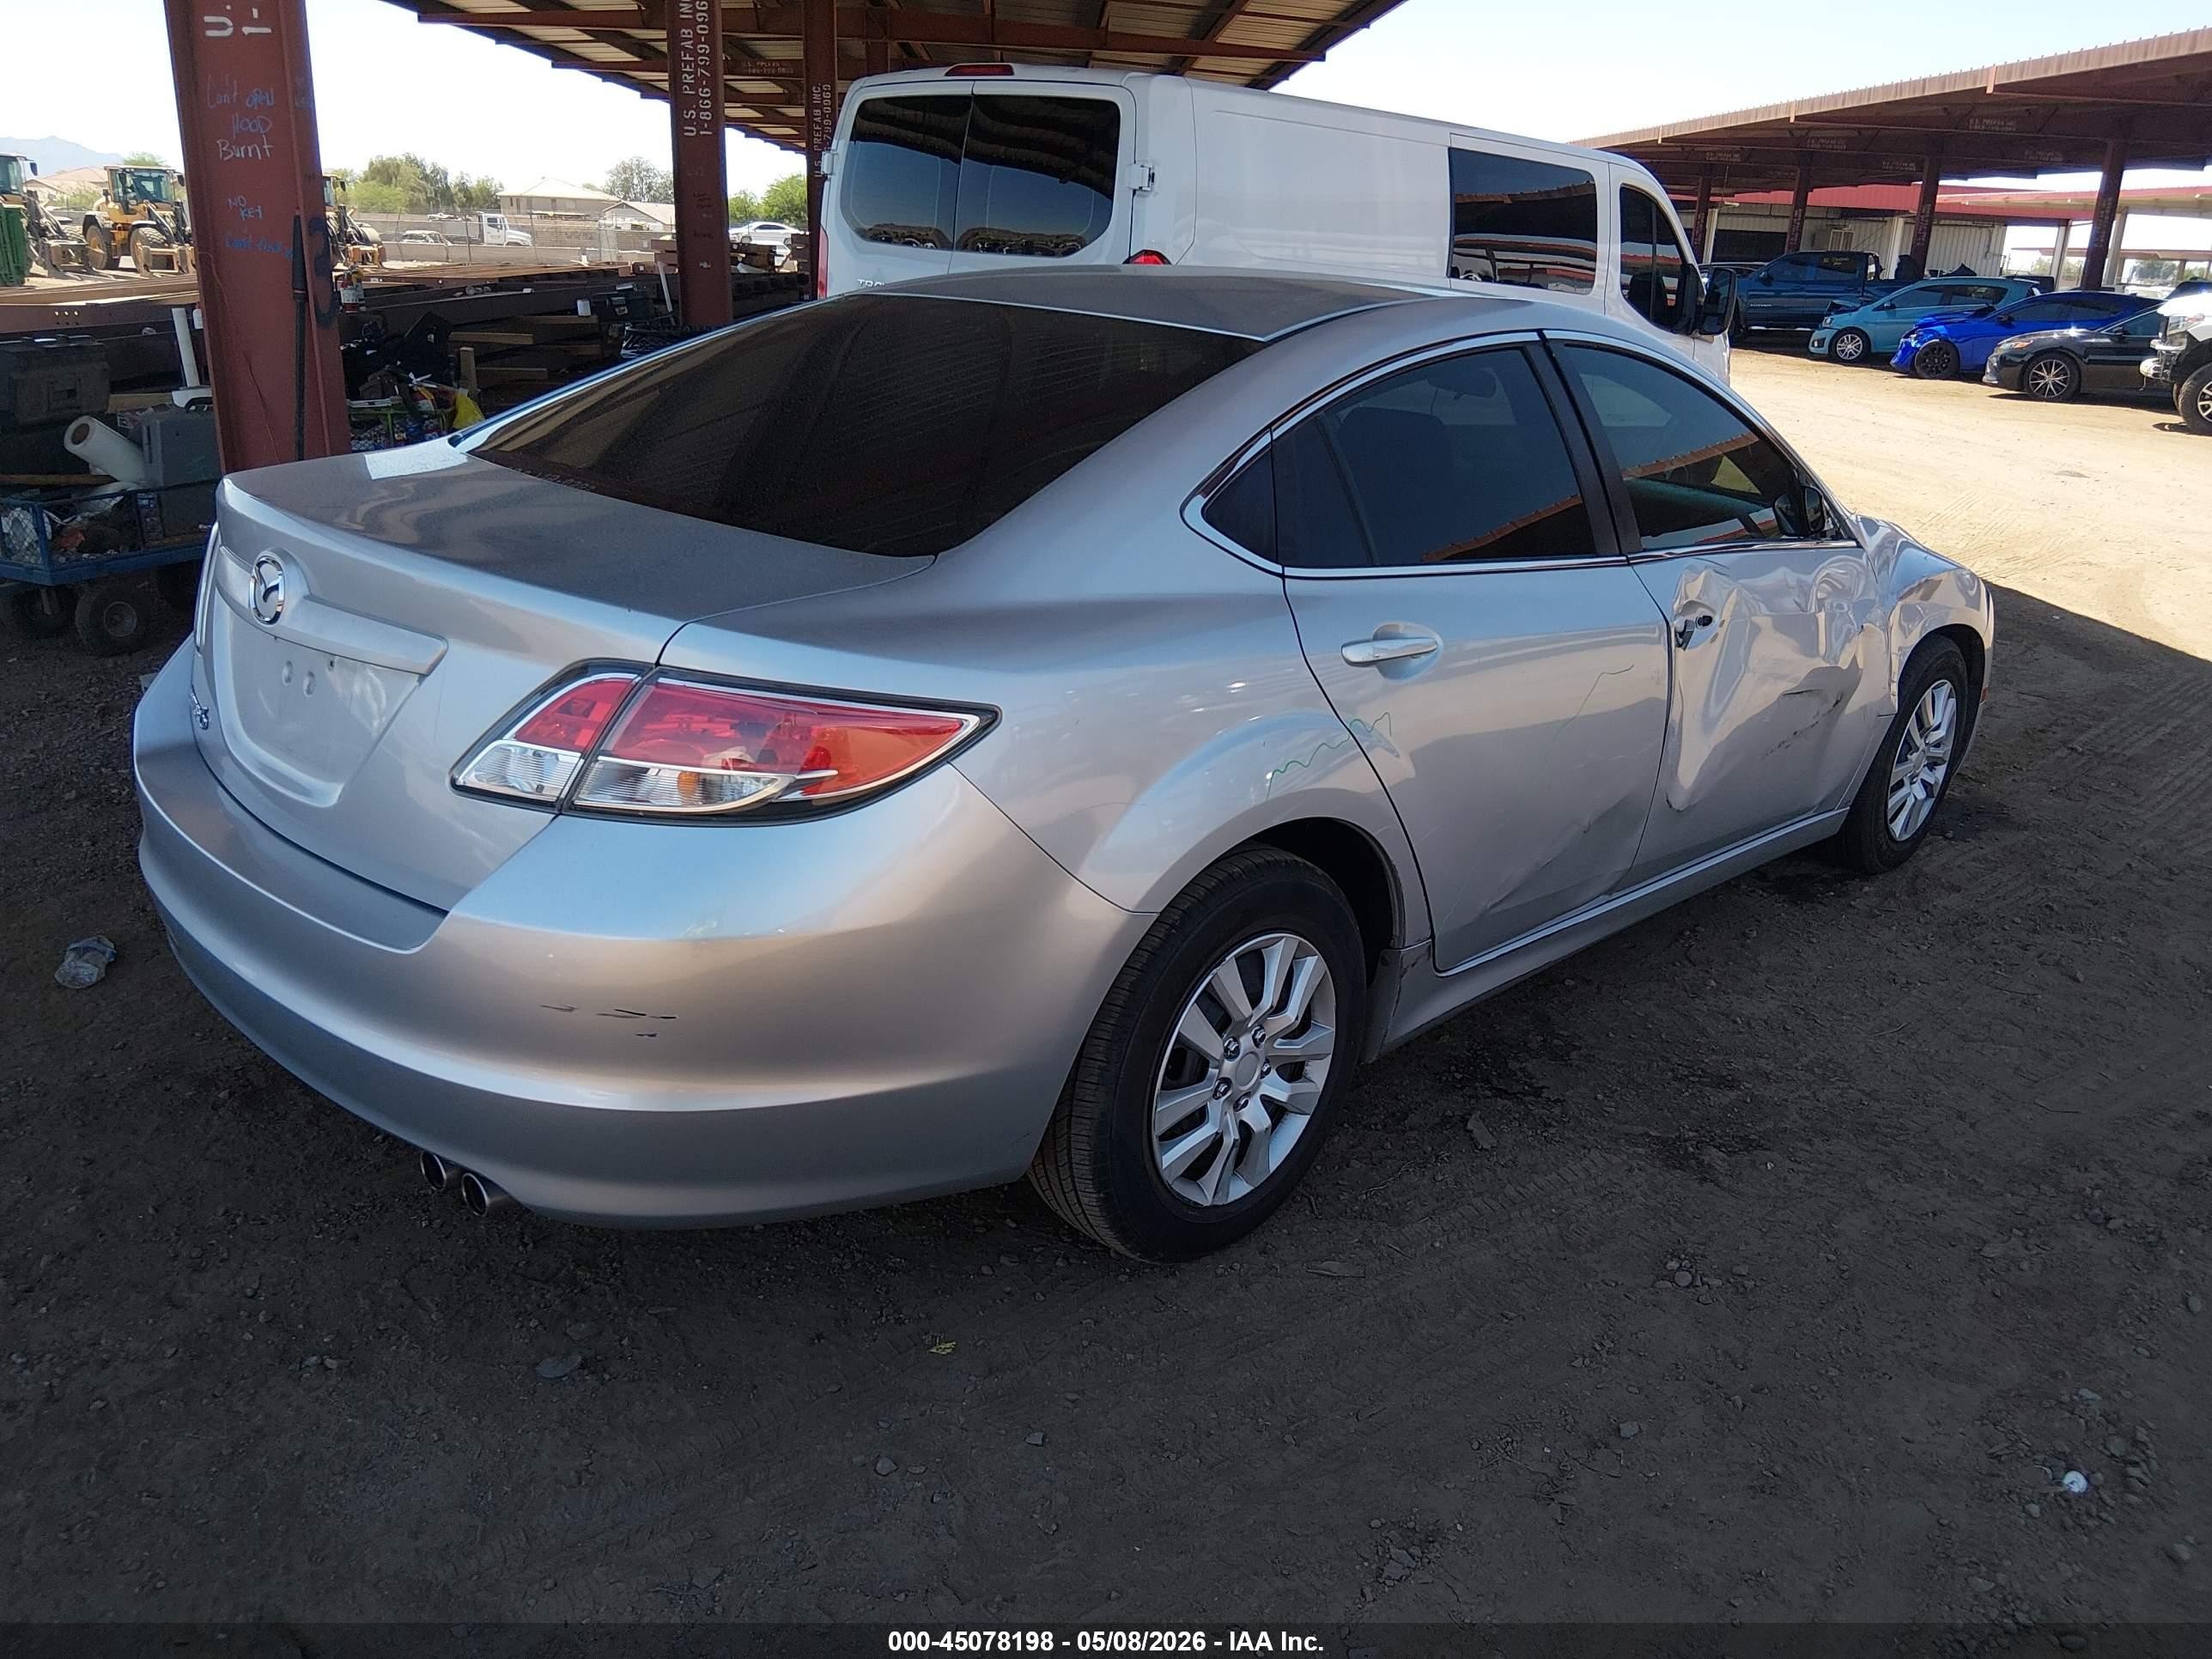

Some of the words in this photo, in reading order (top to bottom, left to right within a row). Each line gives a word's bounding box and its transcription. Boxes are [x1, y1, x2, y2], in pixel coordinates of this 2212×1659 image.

[680, 28, 696, 94] PREFAB
[684, 105, 696, 137] U.S.
[813, 109, 823, 151] PREFAB
[216, 134, 274, 161] Burnt
